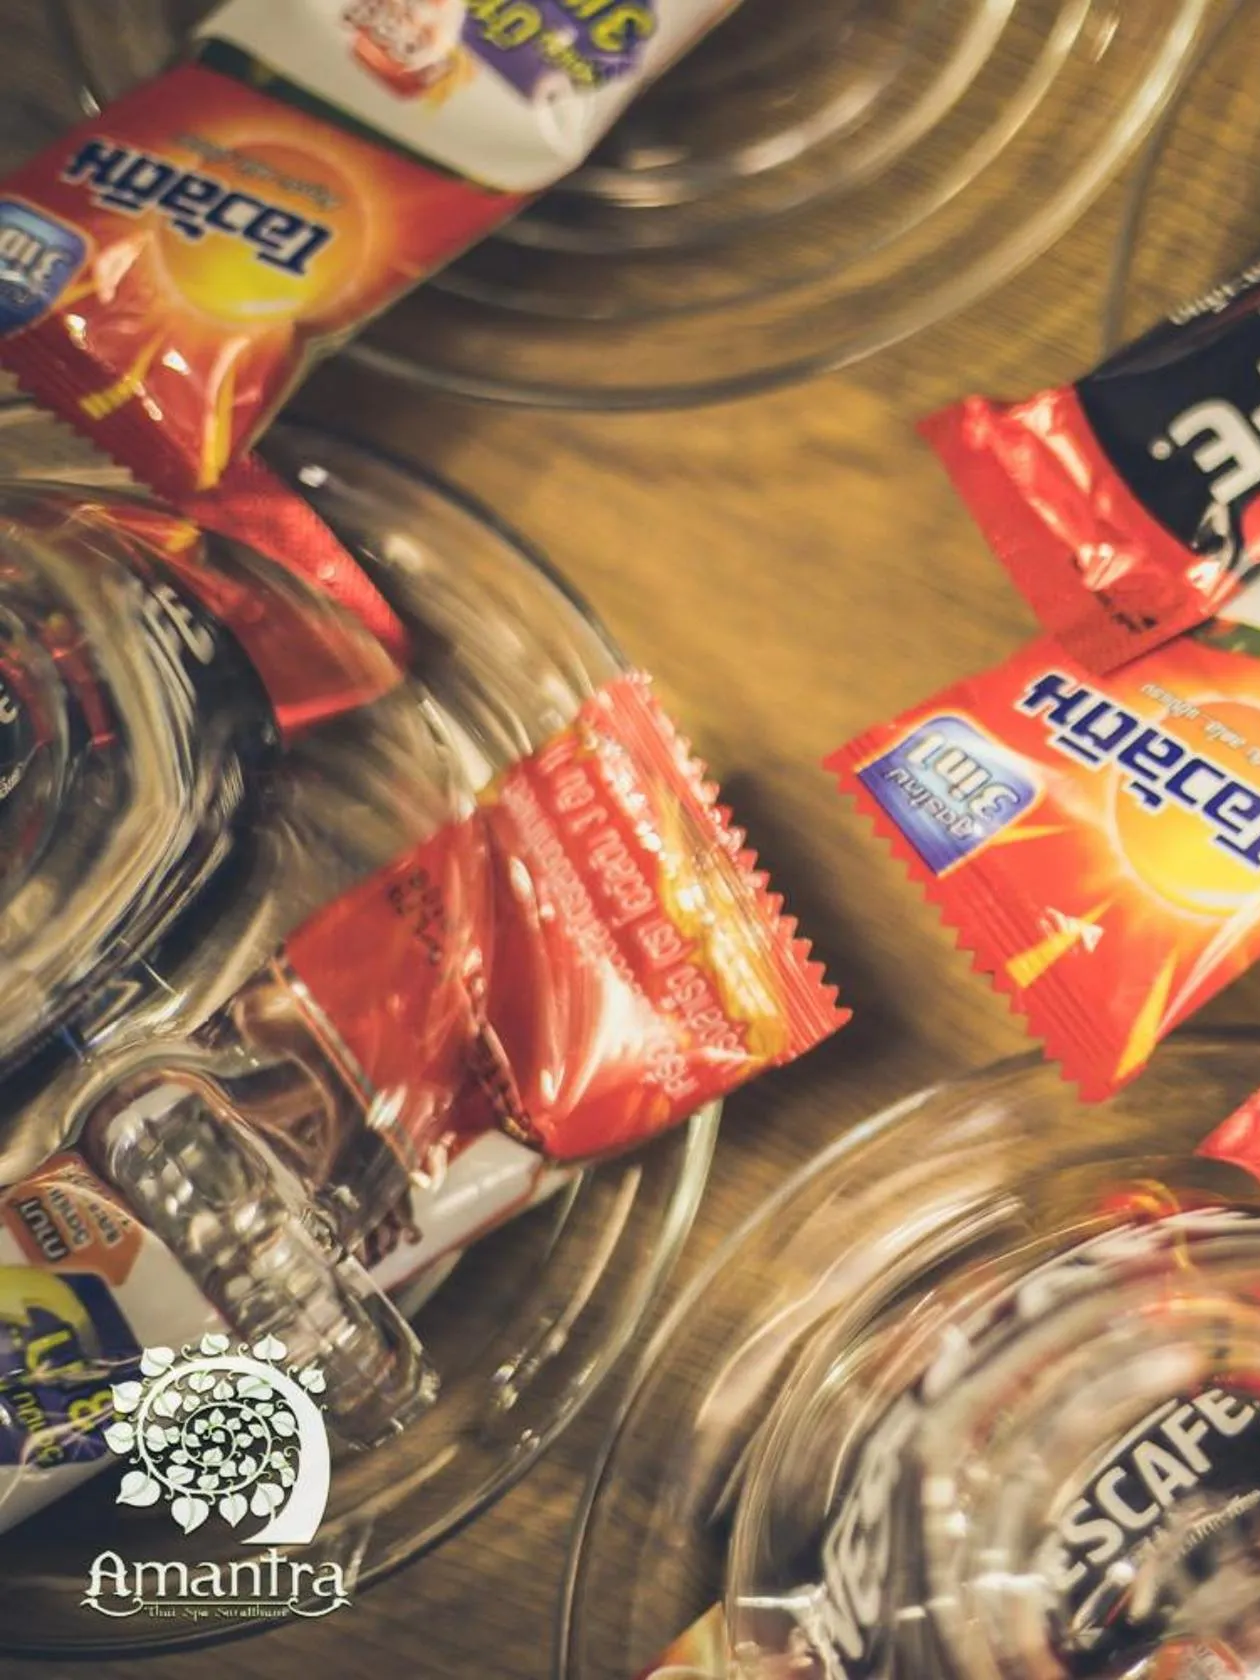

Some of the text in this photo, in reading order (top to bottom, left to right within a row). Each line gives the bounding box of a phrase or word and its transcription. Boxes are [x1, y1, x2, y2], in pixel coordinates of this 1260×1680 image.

[64, 139, 332, 277] โอวัลติน
[1040, 1387, 1258, 1592] ESCAFE
